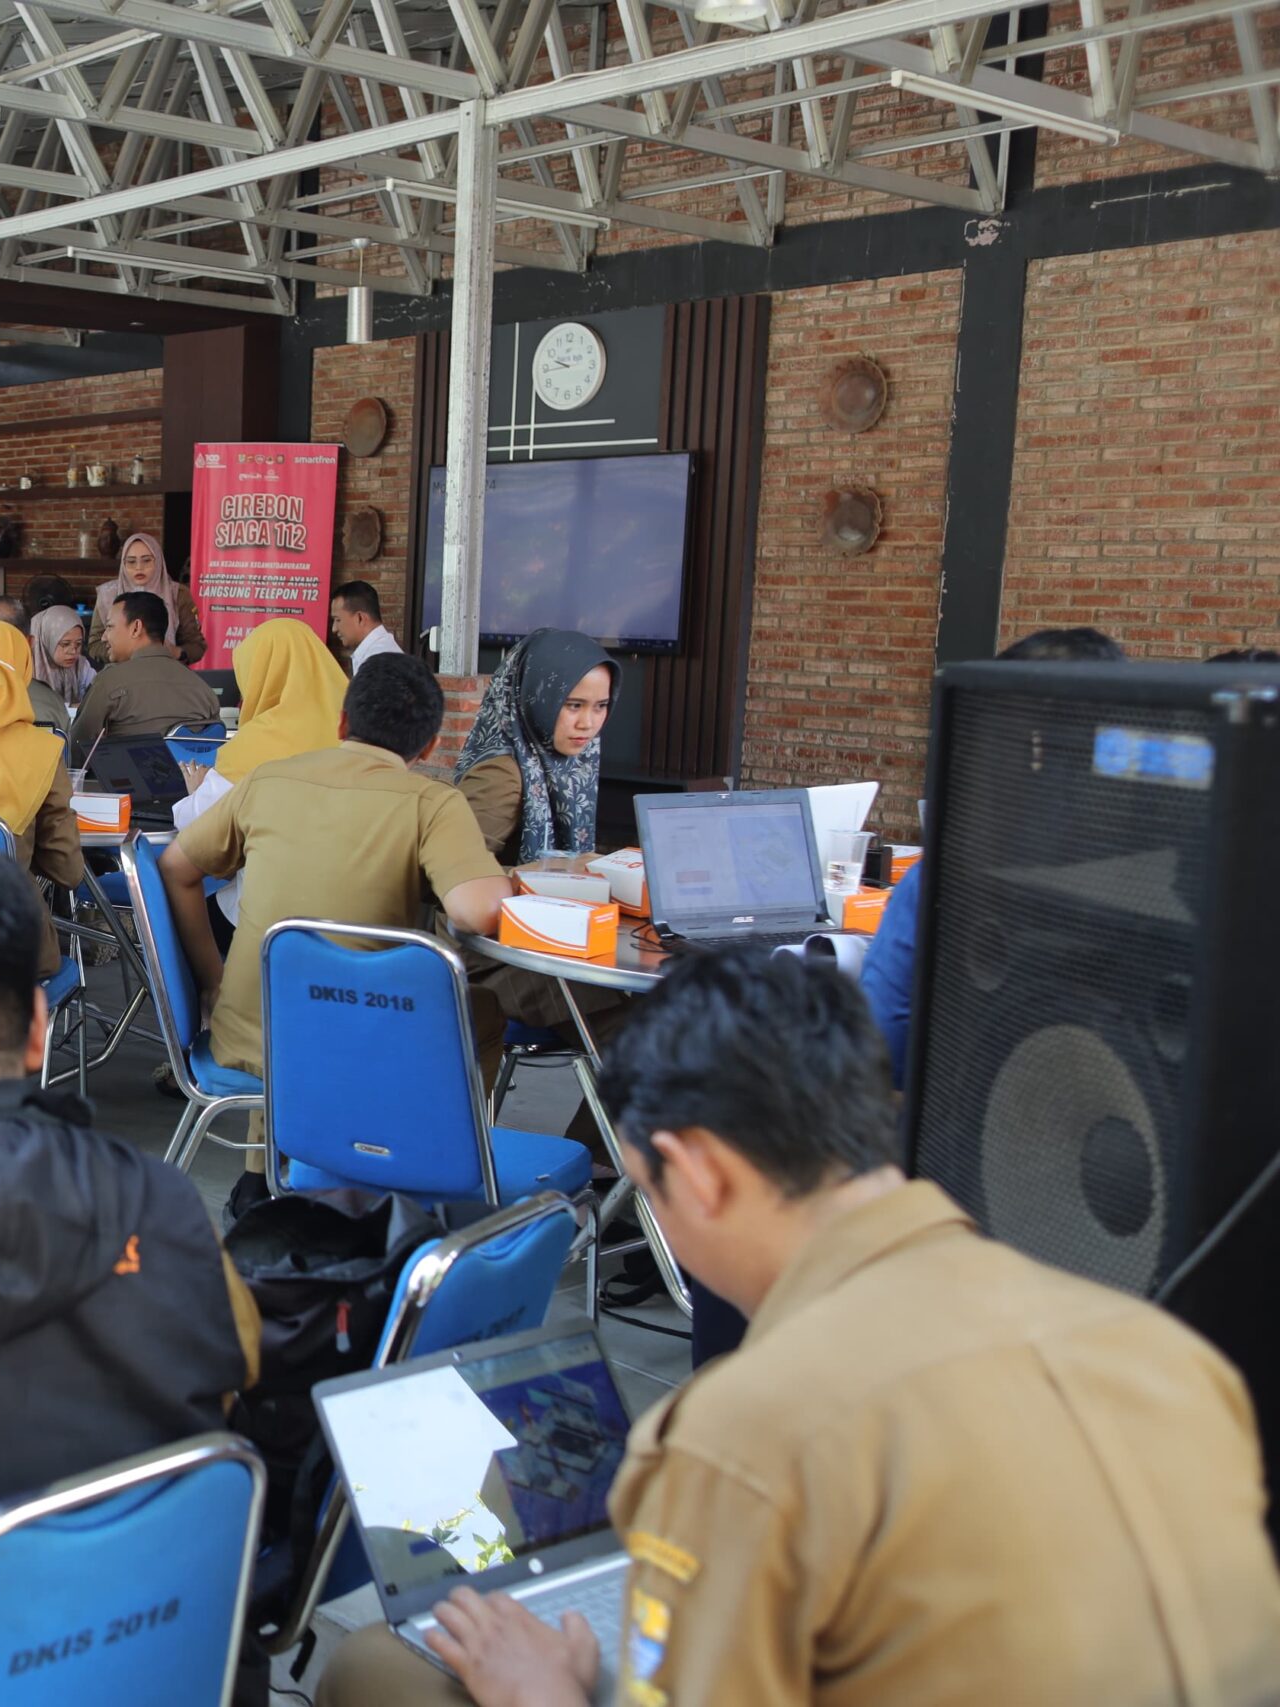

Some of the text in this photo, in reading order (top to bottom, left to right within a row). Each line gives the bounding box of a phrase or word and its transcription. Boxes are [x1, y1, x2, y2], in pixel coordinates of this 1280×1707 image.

[566, 333, 574, 343] 12
[548, 348, 556, 358] 10
[294, 455, 336, 464] smartfren
[222, 493, 304, 523] CIREBON
[215, 520, 307, 550] SIAGA 112
[199, 573, 320, 587] LANGSUNG TELEPON AYANG
[199, 586, 320, 601] LANGSUNG TELEPON 112
[226, 626, 243, 637] AJA
[309, 984, 415, 1012] DKIS 2018
[8, 1597, 181, 1678] DKIS 2018
